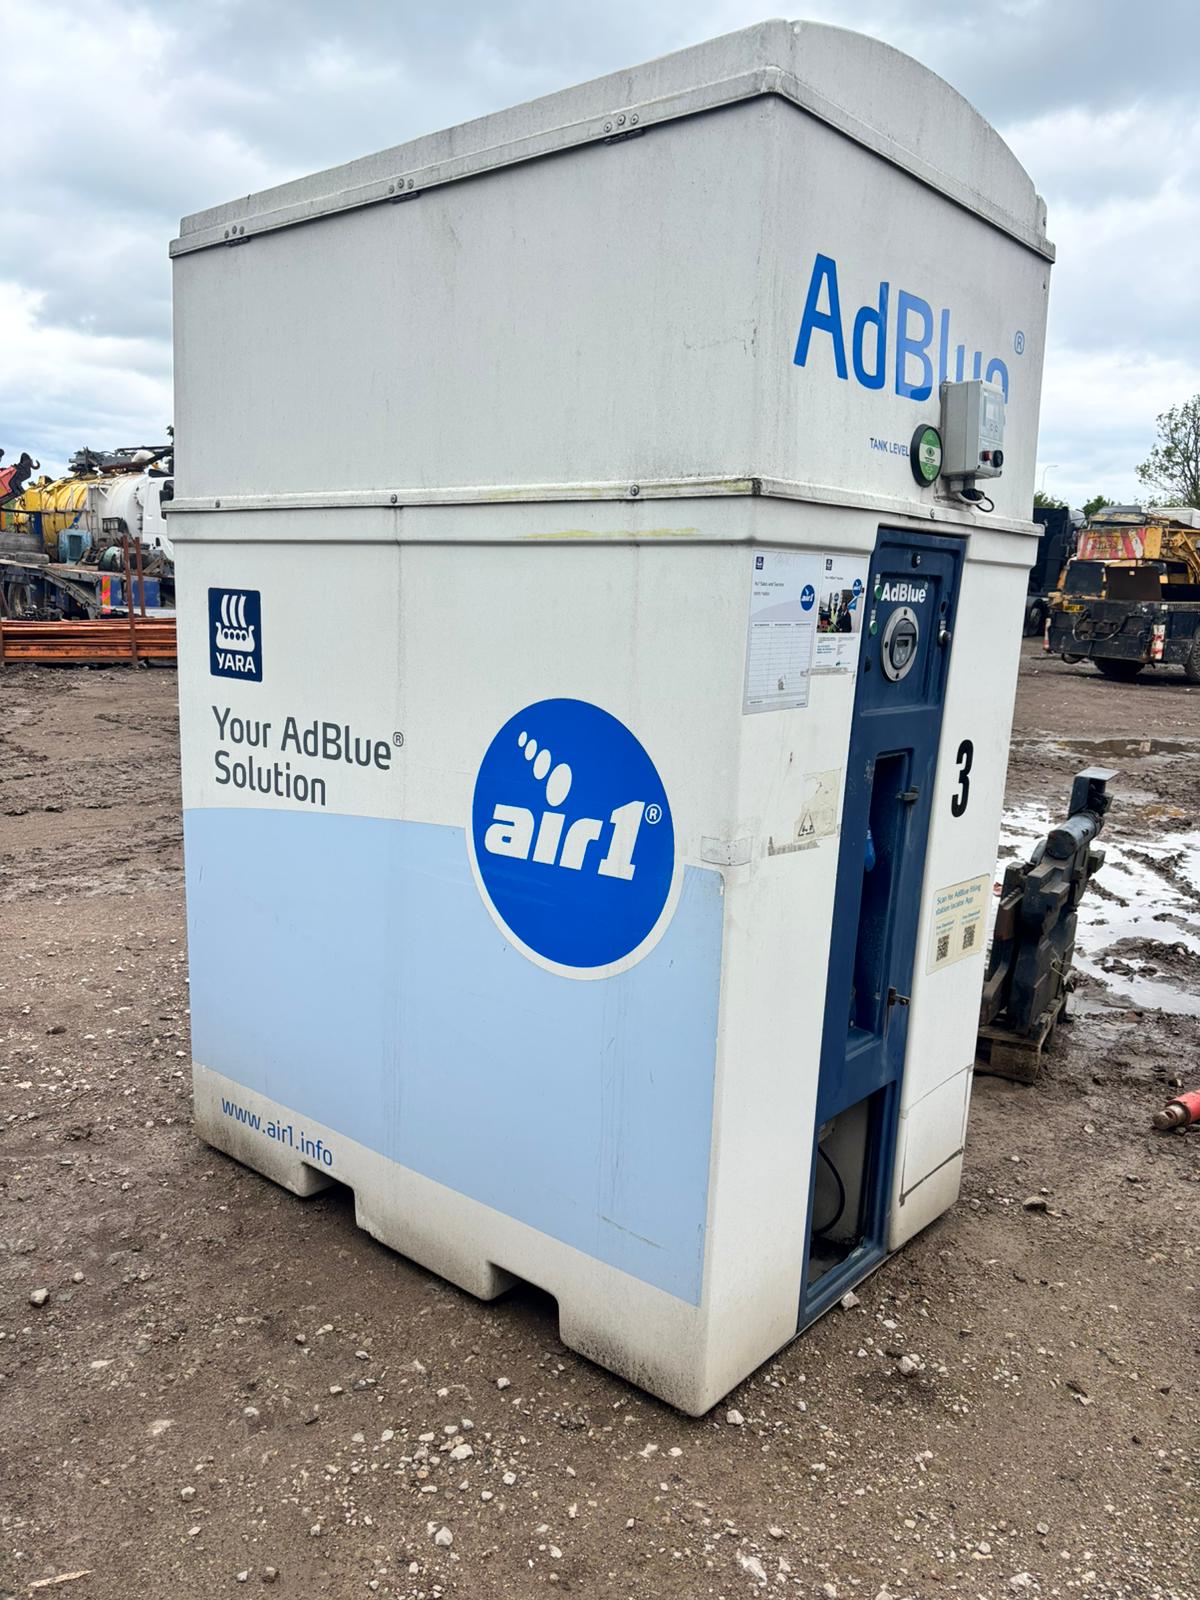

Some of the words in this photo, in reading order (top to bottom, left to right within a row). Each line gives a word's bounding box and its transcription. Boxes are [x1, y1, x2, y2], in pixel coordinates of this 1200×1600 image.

[869, 438, 888, 452] TANK
[889, 442, 910, 458] LEVEL
[216, 652, 256, 673] YARA
[212, 705, 272, 748] Your
[214, 750, 326, 806] Solution
[951, 739, 974, 818] 3
[221, 1097, 333, 1167] www.air1.info
